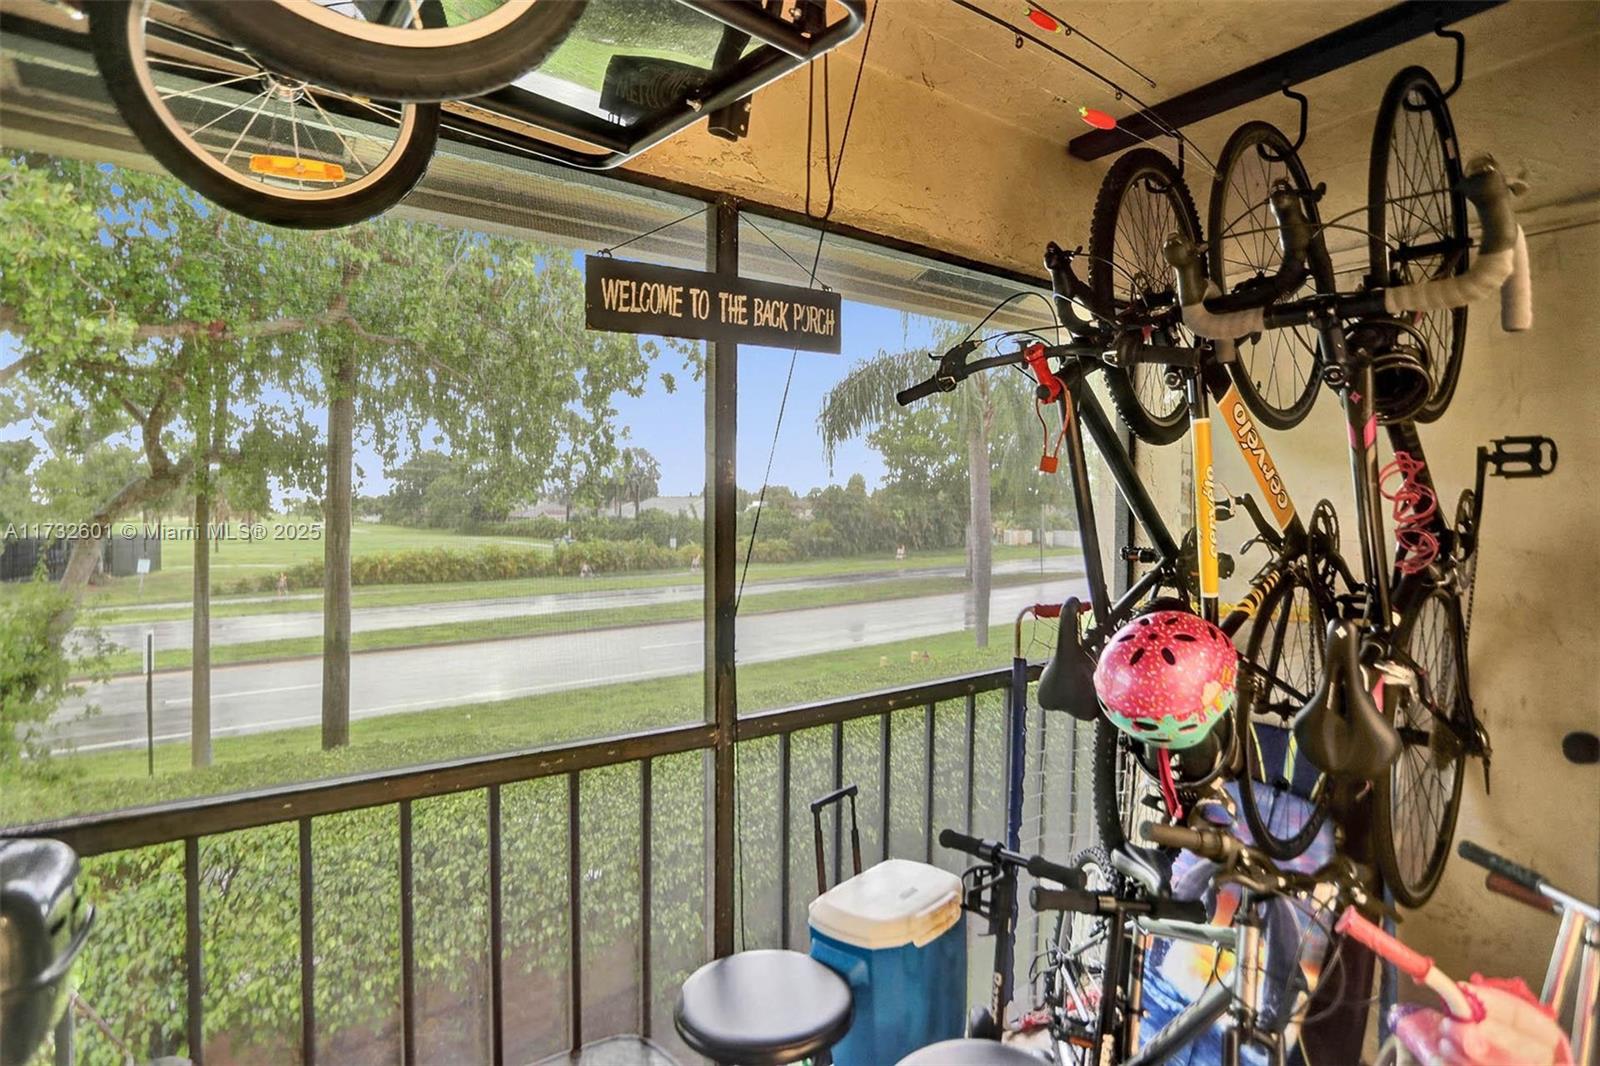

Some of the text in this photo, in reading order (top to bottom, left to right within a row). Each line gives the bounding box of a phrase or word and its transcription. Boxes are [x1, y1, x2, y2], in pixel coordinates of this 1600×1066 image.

[601, 277, 836, 337] WELCOME TO THE BACK PORCH
[1231, 401, 1289, 510] cervélo
